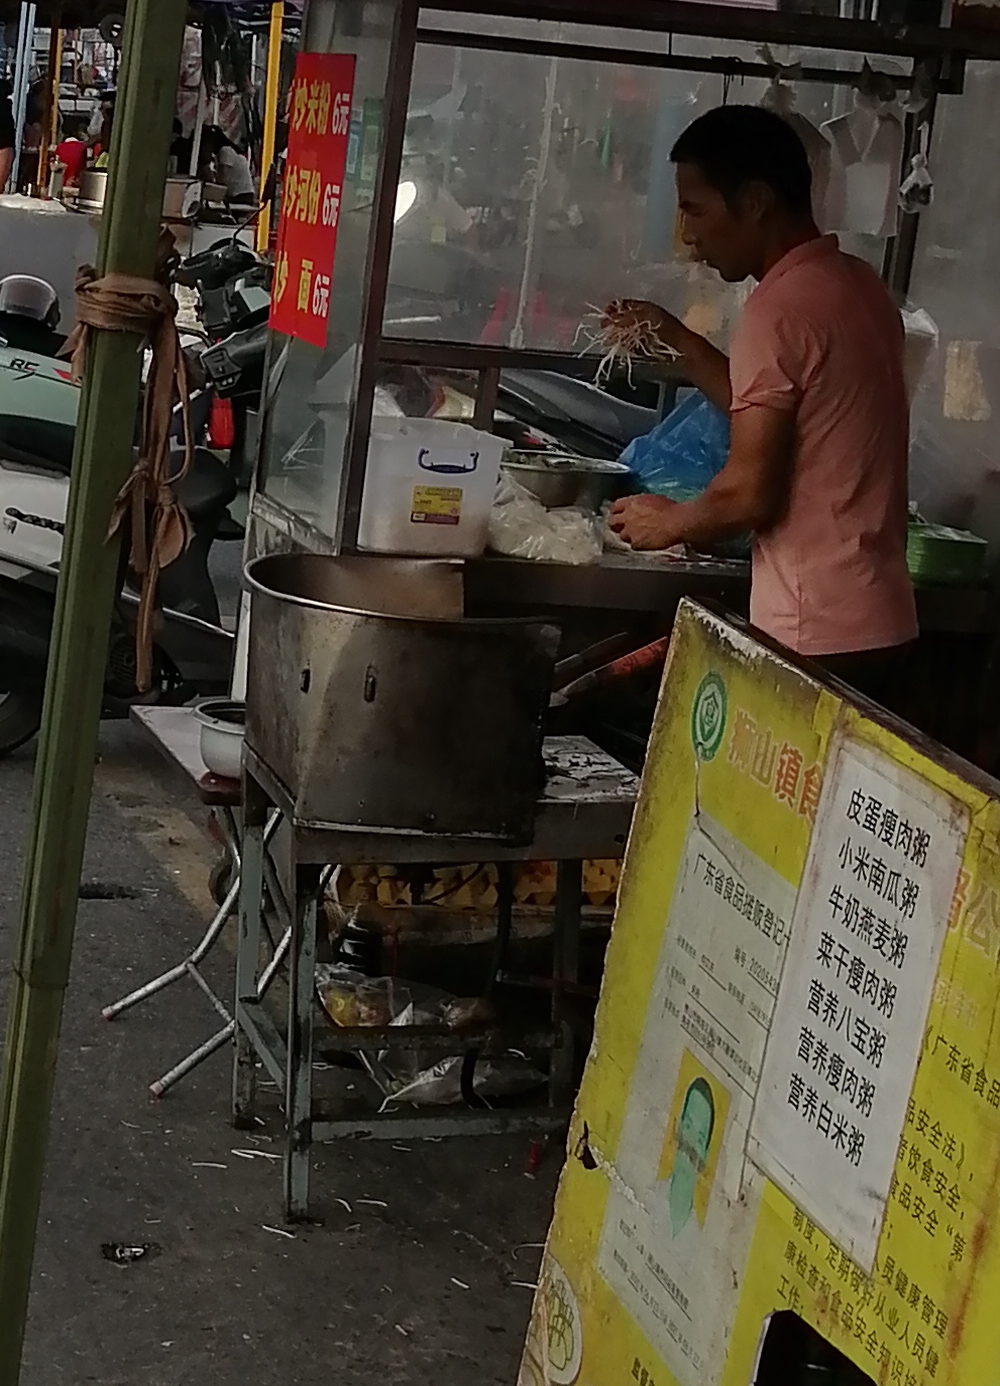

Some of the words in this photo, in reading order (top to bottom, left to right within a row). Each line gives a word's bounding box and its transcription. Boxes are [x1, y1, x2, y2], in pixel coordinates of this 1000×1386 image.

[292, 78, 330, 135] 炒米粉
[332, 92, 350, 134] 6元
[322, 183, 340, 227] 6元
[312, 273, 330, 318] 6元
[846, 788, 931, 868] 皮蛋瘦肉粥
[838, 836, 920, 919] 小米南瓜粥
[828, 884, 909, 969] 牛奶燕麦粥
[816, 931, 898, 1019] 菜干瘦肉粥
[806, 978, 887, 1069] 营养八宝粥
[797, 1025, 876, 1118] 营养瘦肉粥
[787, 1072, 866, 1167] 营养白米粥
